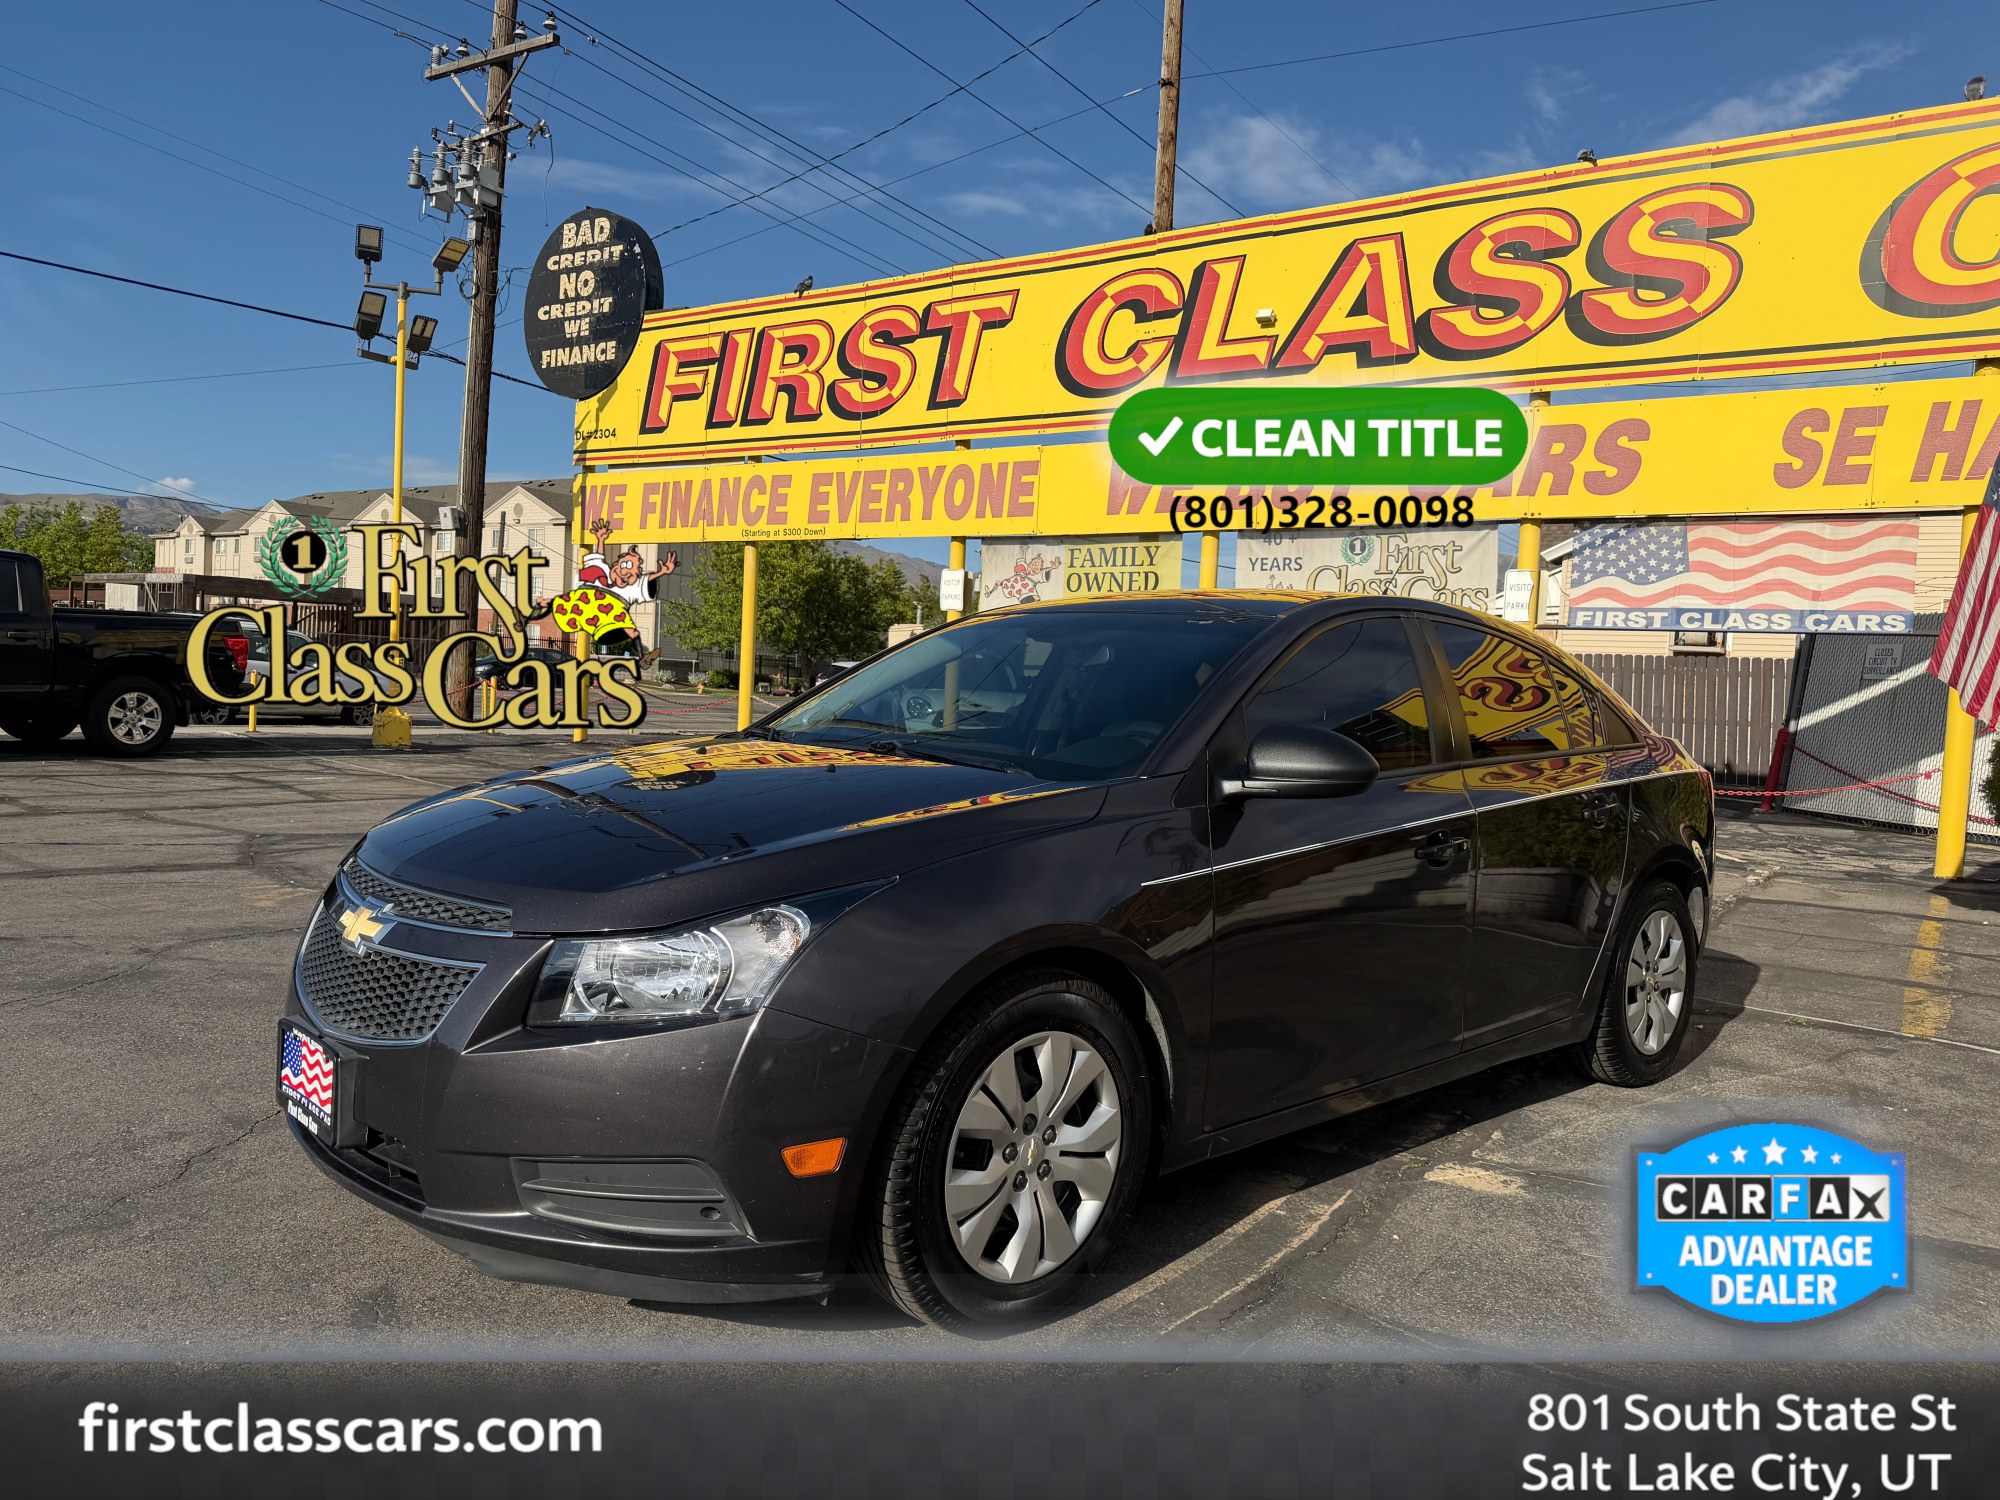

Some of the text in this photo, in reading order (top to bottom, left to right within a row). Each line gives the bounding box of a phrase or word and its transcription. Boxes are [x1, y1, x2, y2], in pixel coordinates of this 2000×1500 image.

[562, 217, 611, 250] BAD
[547, 244, 624, 271] CREDIT
[559, 270, 595, 300] NO
[537, 296, 613, 321] CREDIT
[639, 289, 1020, 436] FIRST
[1055, 182, 1753, 398] CLASS
[564, 319, 590, 338] WE
[541, 341, 616, 369] FINANCE
[576, 428, 616, 441] DL#2304
[1773, 405, 1889, 489] SE
[581, 460, 1041, 530] WE FINANCE EVERYONE
[741, 527, 826, 539] (Starting at $300 Down)
[1263, 532, 1282, 546] 40
[1068, 545, 1161, 568] FAMILY
[1249, 557, 1303, 572] YEARS
[1374, 532, 1463, 590] First
[1066, 571, 1160, 592] OWNED
[1509, 584, 1531, 592] VISITO
[1506, 602, 1528, 610] PARKI
[1575, 611, 1906, 632] FIRST CLASS CARS
[1874, 648, 1894, 657] CLOSED
